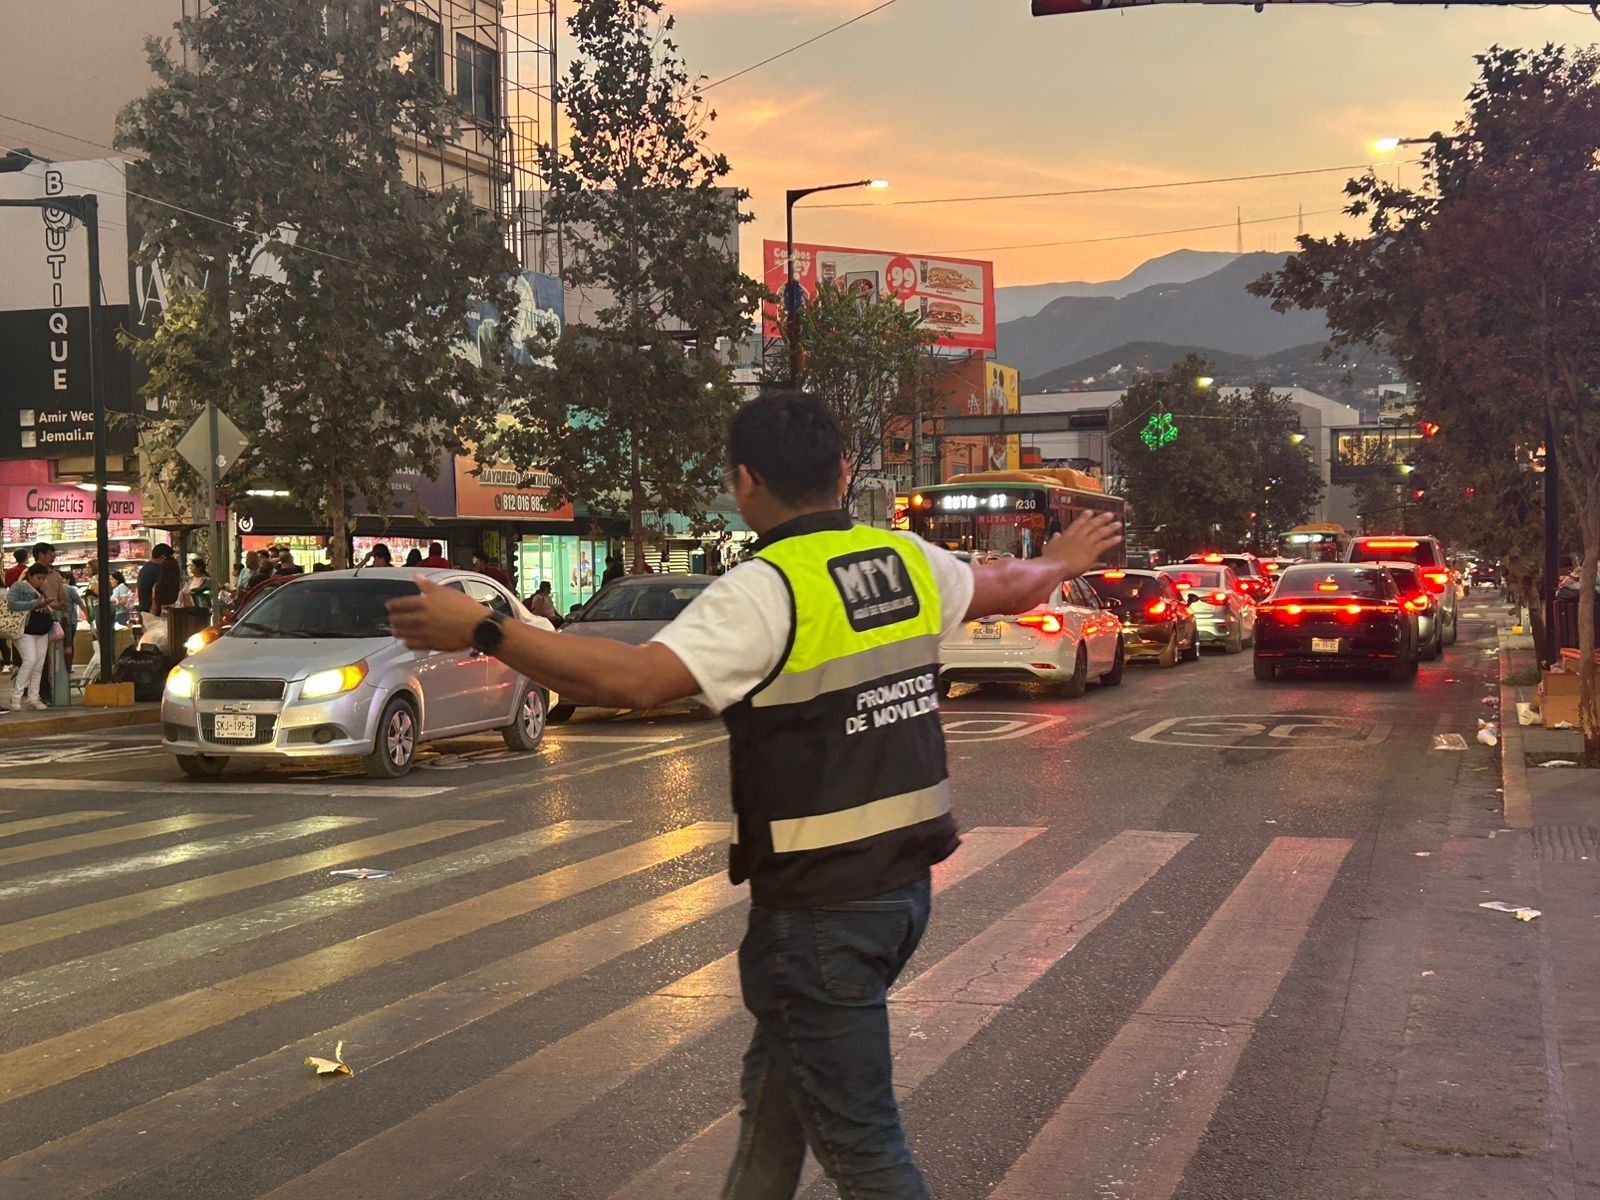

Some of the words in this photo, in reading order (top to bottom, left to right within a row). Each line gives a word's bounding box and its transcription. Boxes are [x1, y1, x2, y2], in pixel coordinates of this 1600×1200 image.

[45, 170, 68, 390] BOUTIQUE
[39, 410, 68, 423] Amir
[26, 488, 84, 513] Cosmetics
[92, 500, 135, 516] yoreo
[502, 494, 516, 511] 812
[517, 495, 530, 511] 016
[943, 495, 977, 510] RUTA
[834, 554, 903, 603] MTY
[856, 673, 936, 712] PROMOTOR
[845, 713, 870, 736] DE
